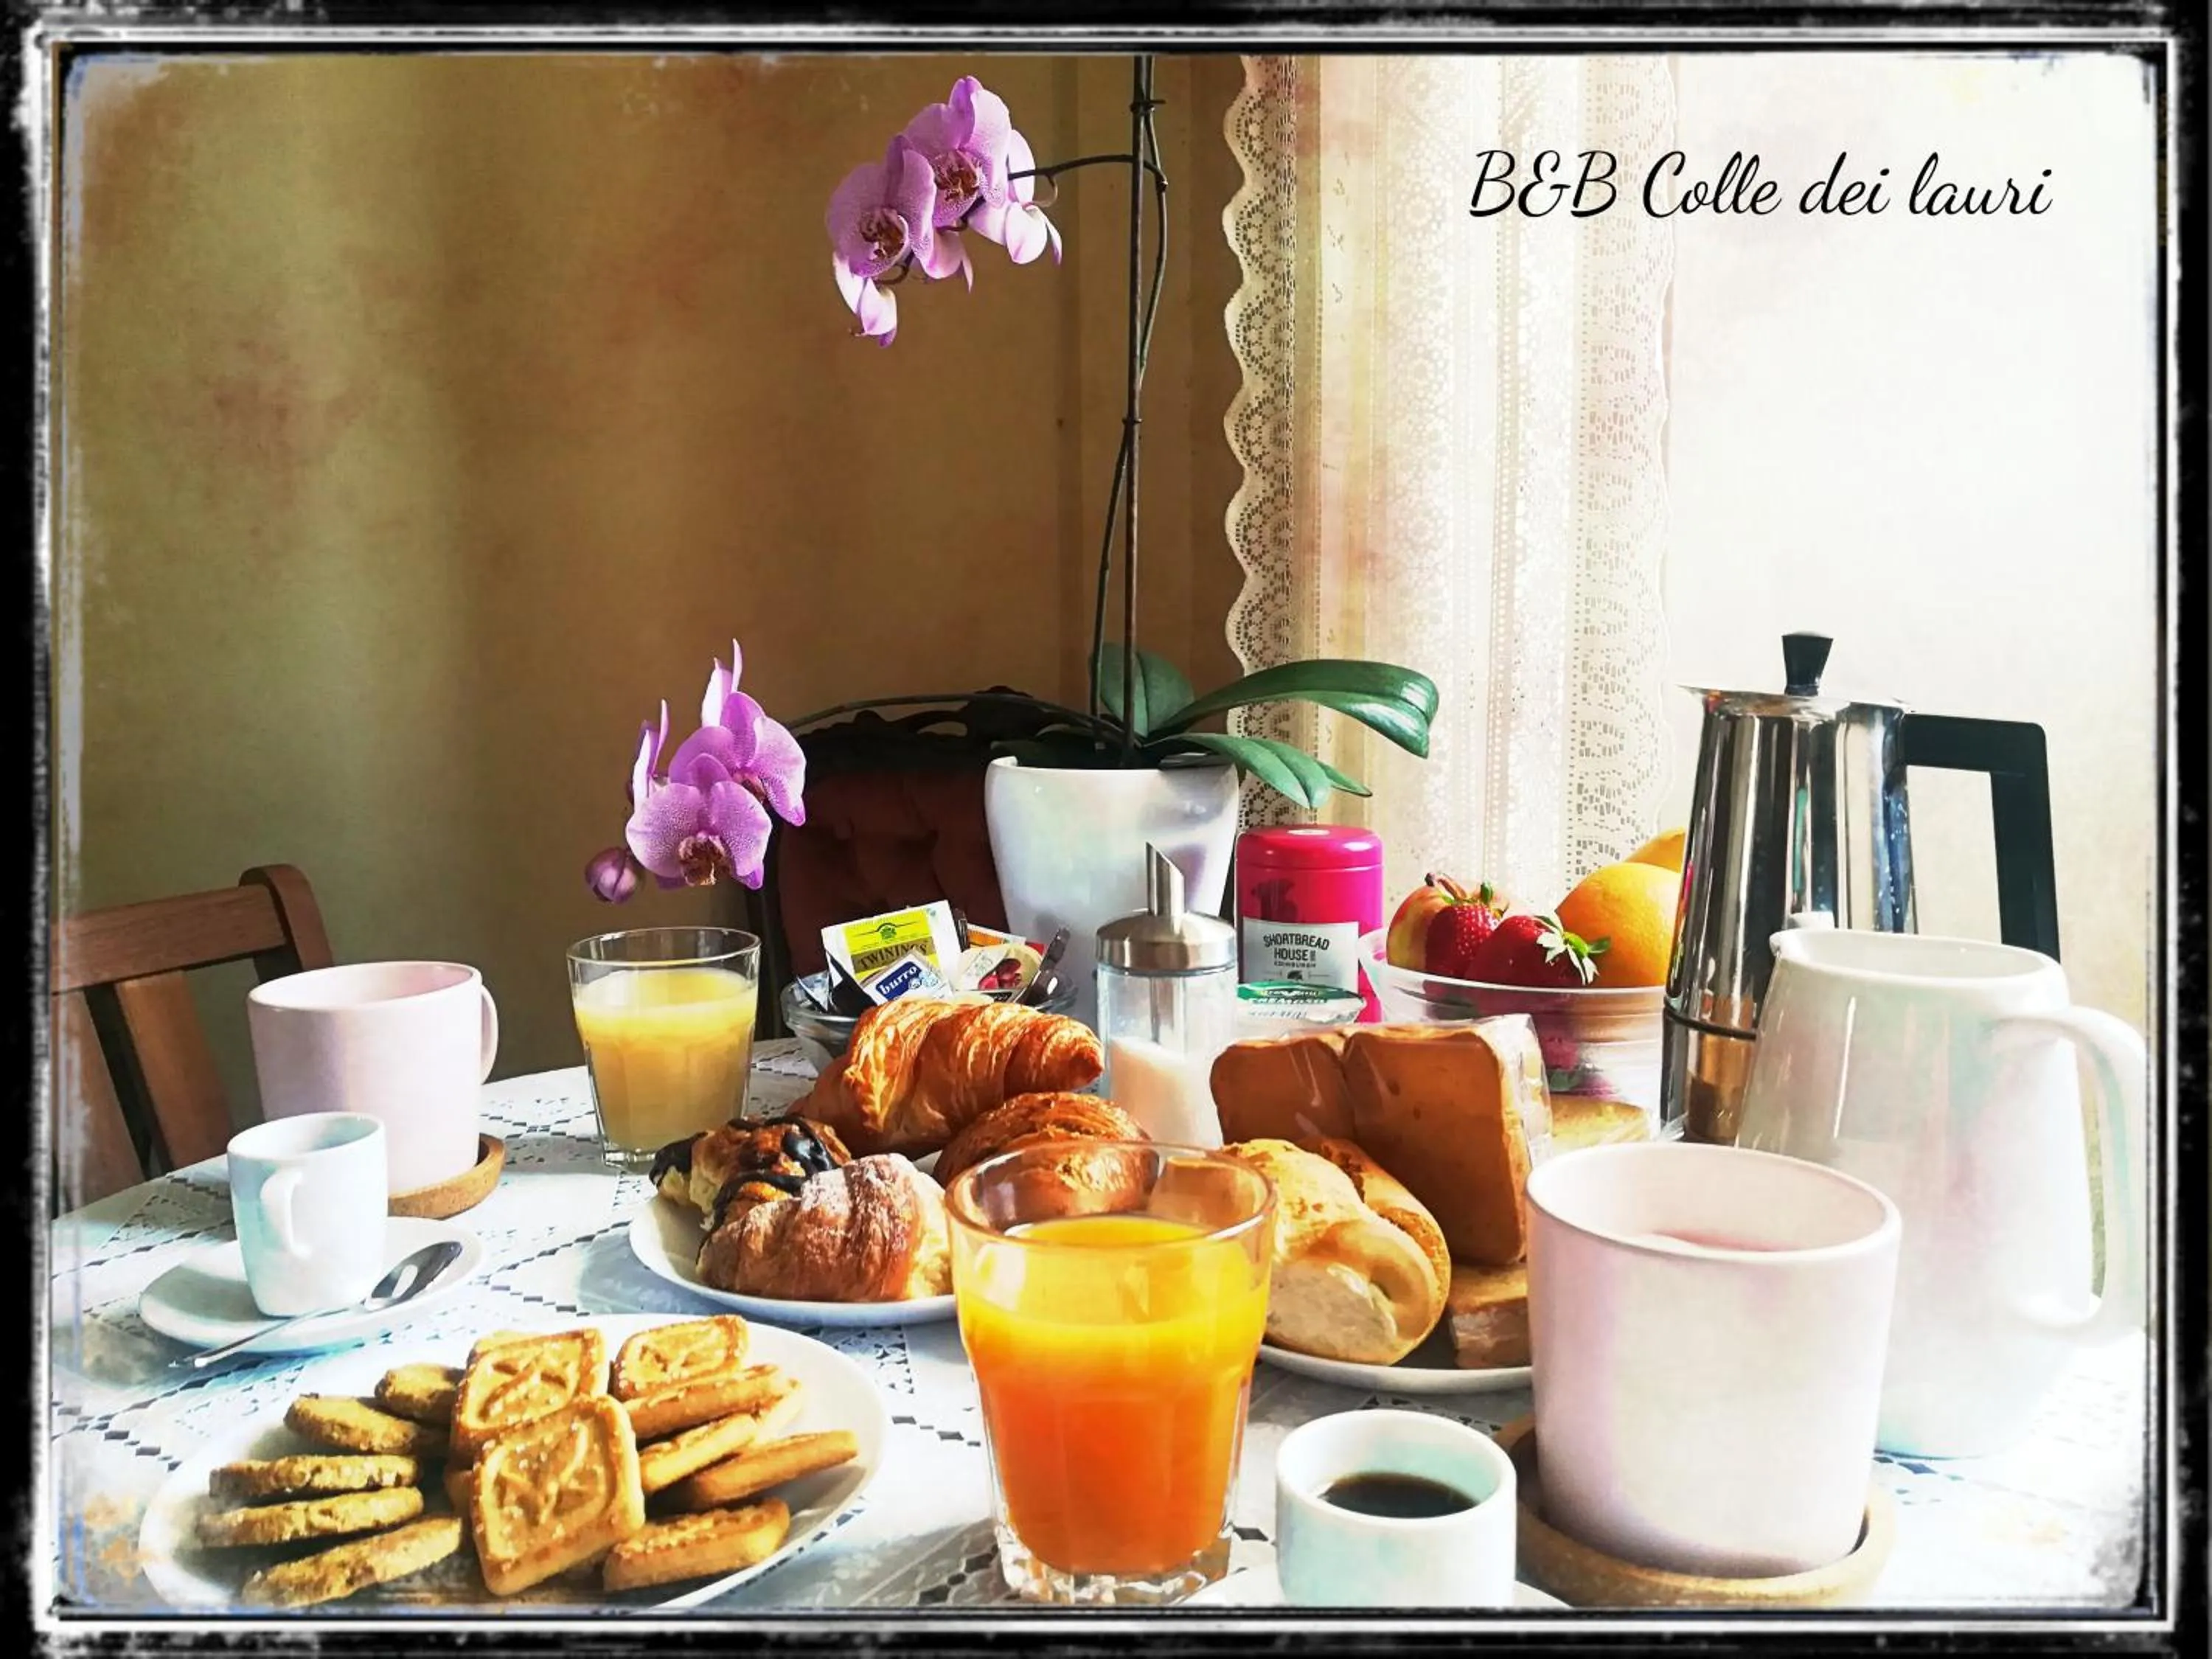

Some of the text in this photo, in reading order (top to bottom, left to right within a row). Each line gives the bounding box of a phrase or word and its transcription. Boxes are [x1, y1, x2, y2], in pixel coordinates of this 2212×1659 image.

[1263, 933, 1330, 950] SHORTBREAD
[1273, 948, 1309, 961] HOUSE
[878, 966, 918, 995] burro
